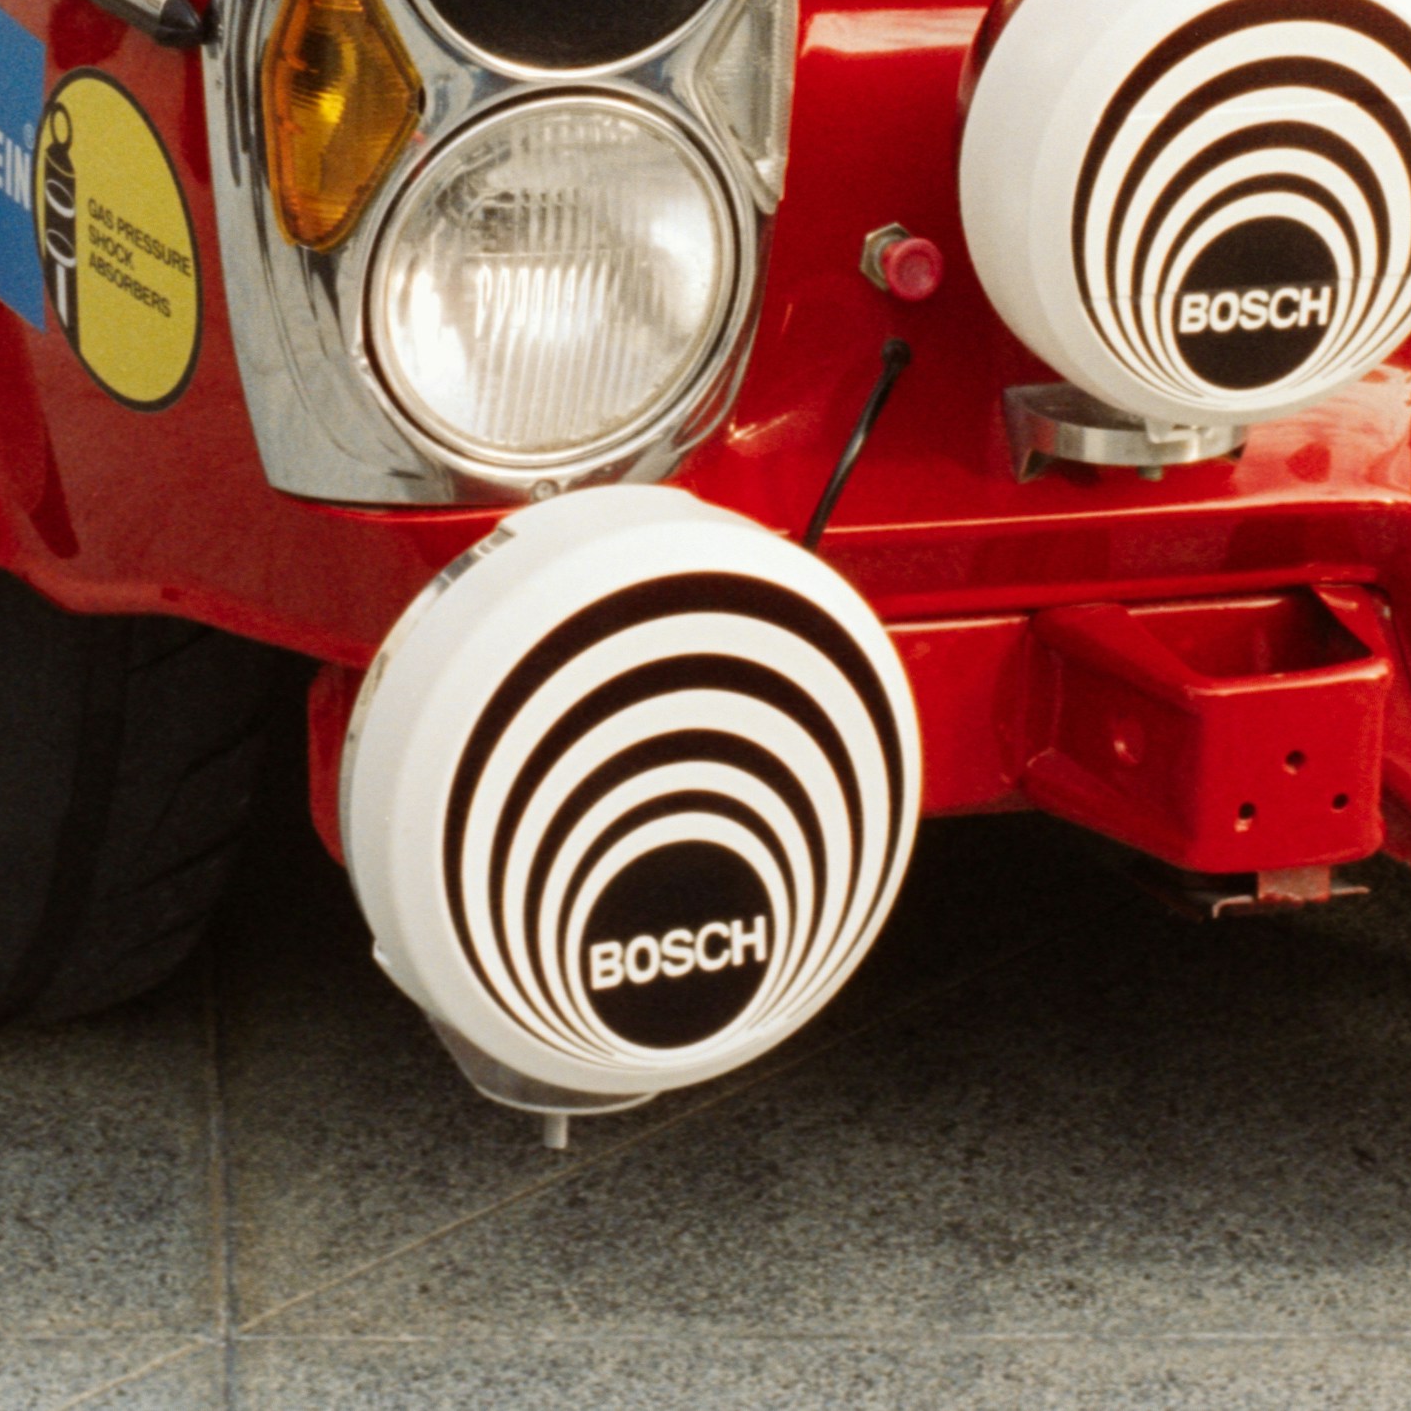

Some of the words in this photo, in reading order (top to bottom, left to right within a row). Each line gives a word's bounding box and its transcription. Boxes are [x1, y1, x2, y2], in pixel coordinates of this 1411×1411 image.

[88, 198, 114, 231] GAS
[117, 216, 192, 278] PRESSURE
[88, 223, 135, 271] SHOCK
[88, 252, 172, 318] ABSORBERS
[1179, 286, 1332, 334] BOSCH
[591, 915, 767, 990] BOSCH
